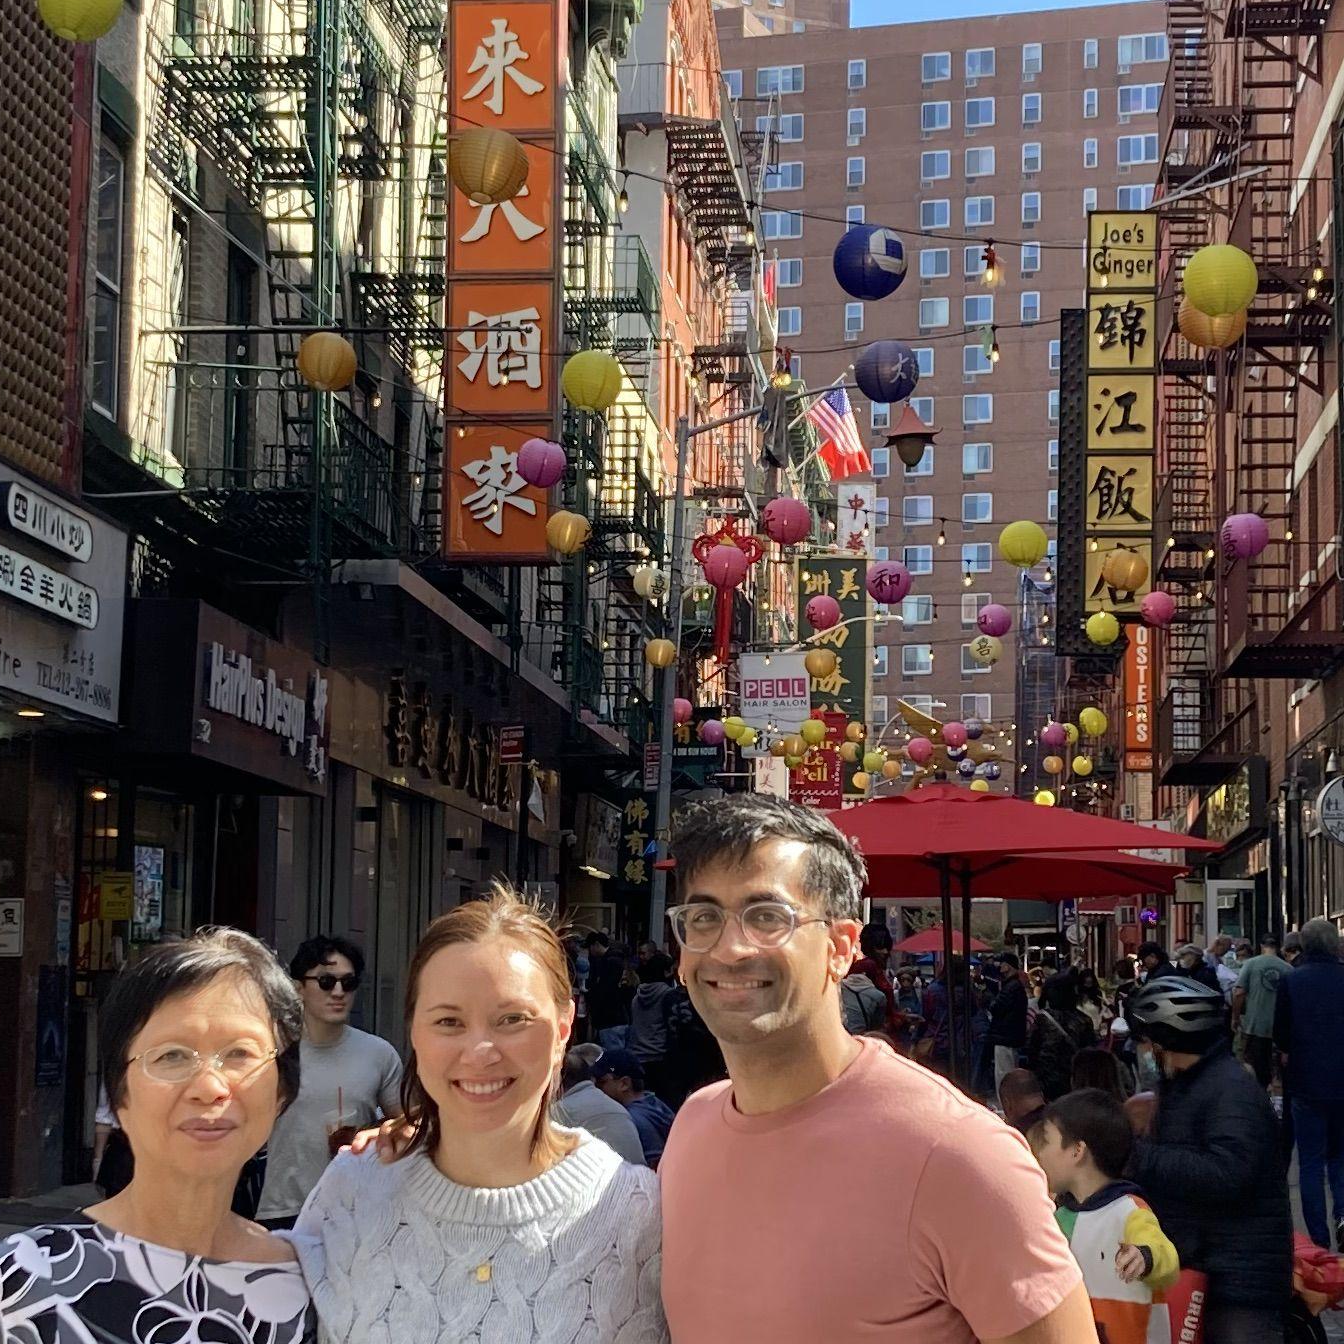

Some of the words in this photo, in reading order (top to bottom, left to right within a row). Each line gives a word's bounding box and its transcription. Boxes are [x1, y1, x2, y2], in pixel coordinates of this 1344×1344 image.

[1102, 220, 1146, 246] Joe's
[1092, 251, 1155, 278] Ginger
[13, 491, 86, 553] 四川小炒
[744, 679, 805, 698] PELL
[743, 699, 769, 707] HAIR
[772, 699, 808, 707] SALON
